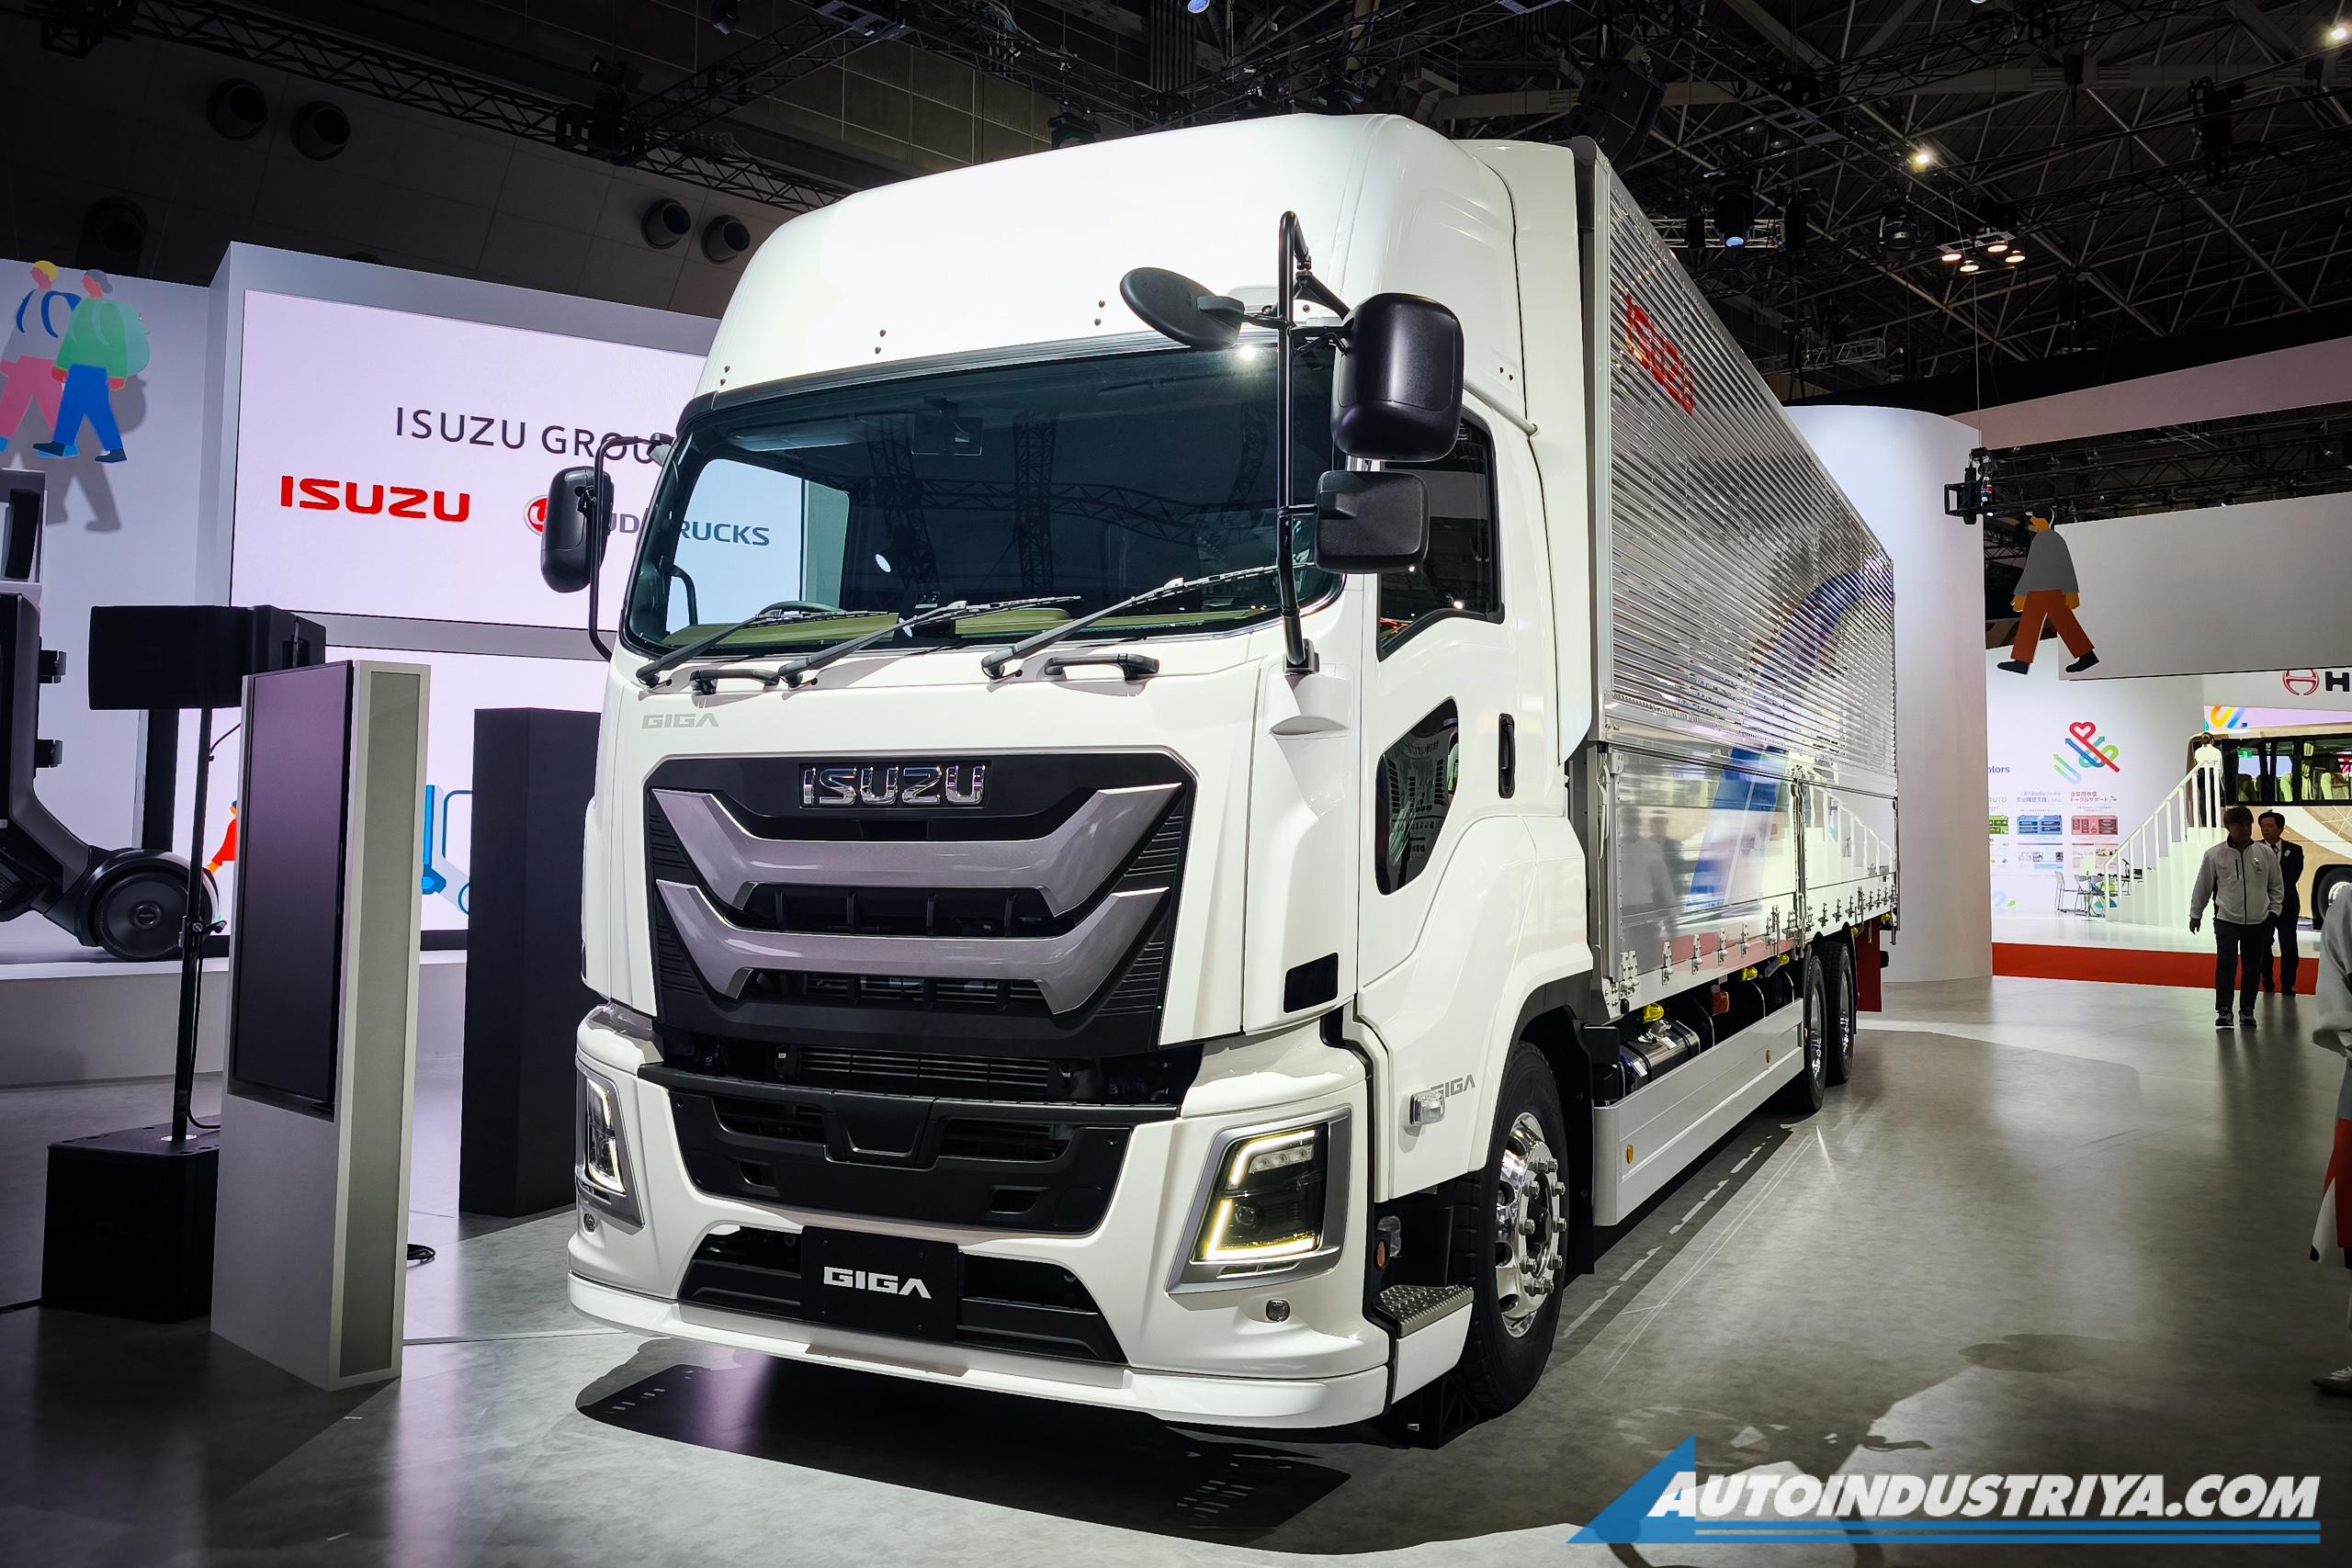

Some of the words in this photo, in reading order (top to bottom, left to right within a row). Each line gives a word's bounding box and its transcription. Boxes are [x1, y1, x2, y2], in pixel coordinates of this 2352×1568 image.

[1624, 293, 1694, 416] ISUZU
[397, 407, 526, 450] ISUZU
[541, 424, 653, 464] GROU
[280, 475, 470, 523] ISUZU
[681, 519, 771, 547] RUCKS
[641, 712, 719, 729] GIGA
[802, 764, 988, 807] ISUZU
[823, 1266, 933, 1300] GIGA
